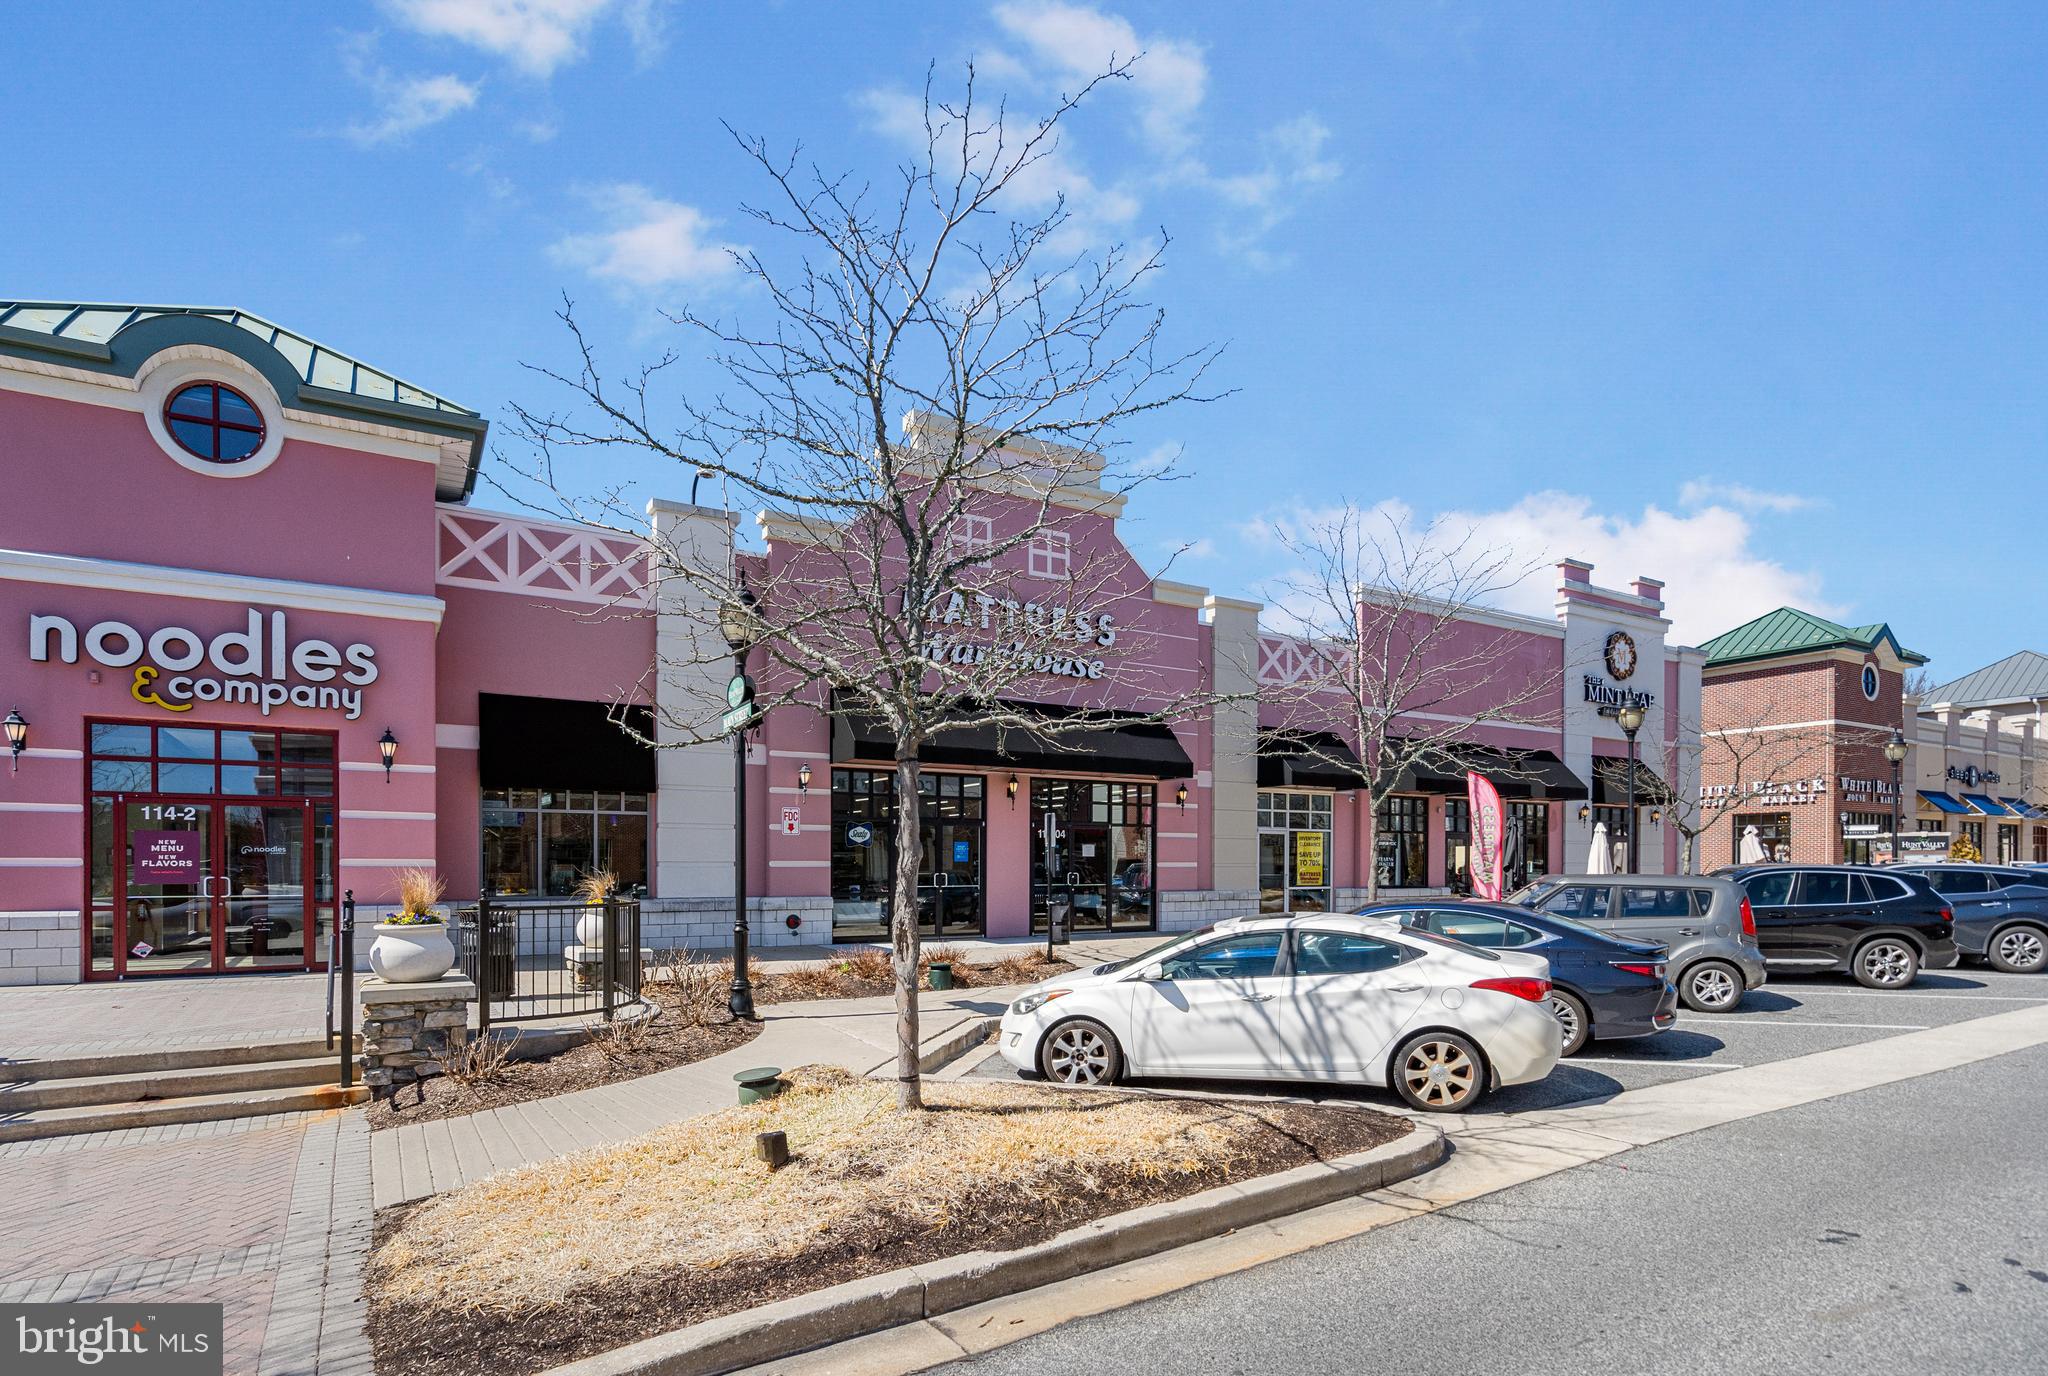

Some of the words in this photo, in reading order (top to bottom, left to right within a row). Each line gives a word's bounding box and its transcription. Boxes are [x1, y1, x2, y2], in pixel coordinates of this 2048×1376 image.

[29, 607, 379, 686] noodles
[167, 676, 362, 720] company
[1588, 684, 1623, 705] MINT
[1950, 768, 1969, 782] sleep
[1752, 779, 1826, 795] BLACK
[1841, 777, 1872, 793] WHITE
[1876, 780, 1904, 795] BLAK
[1761, 794, 1816, 806] MARKET
[141, 805, 196, 821] 114-2
[784, 811, 799, 821] FDC
[850, 829, 869, 840] Sealy
[1901, 841, 1921, 850] HUNT
[1920, 840, 1946, 850] VALLEY
